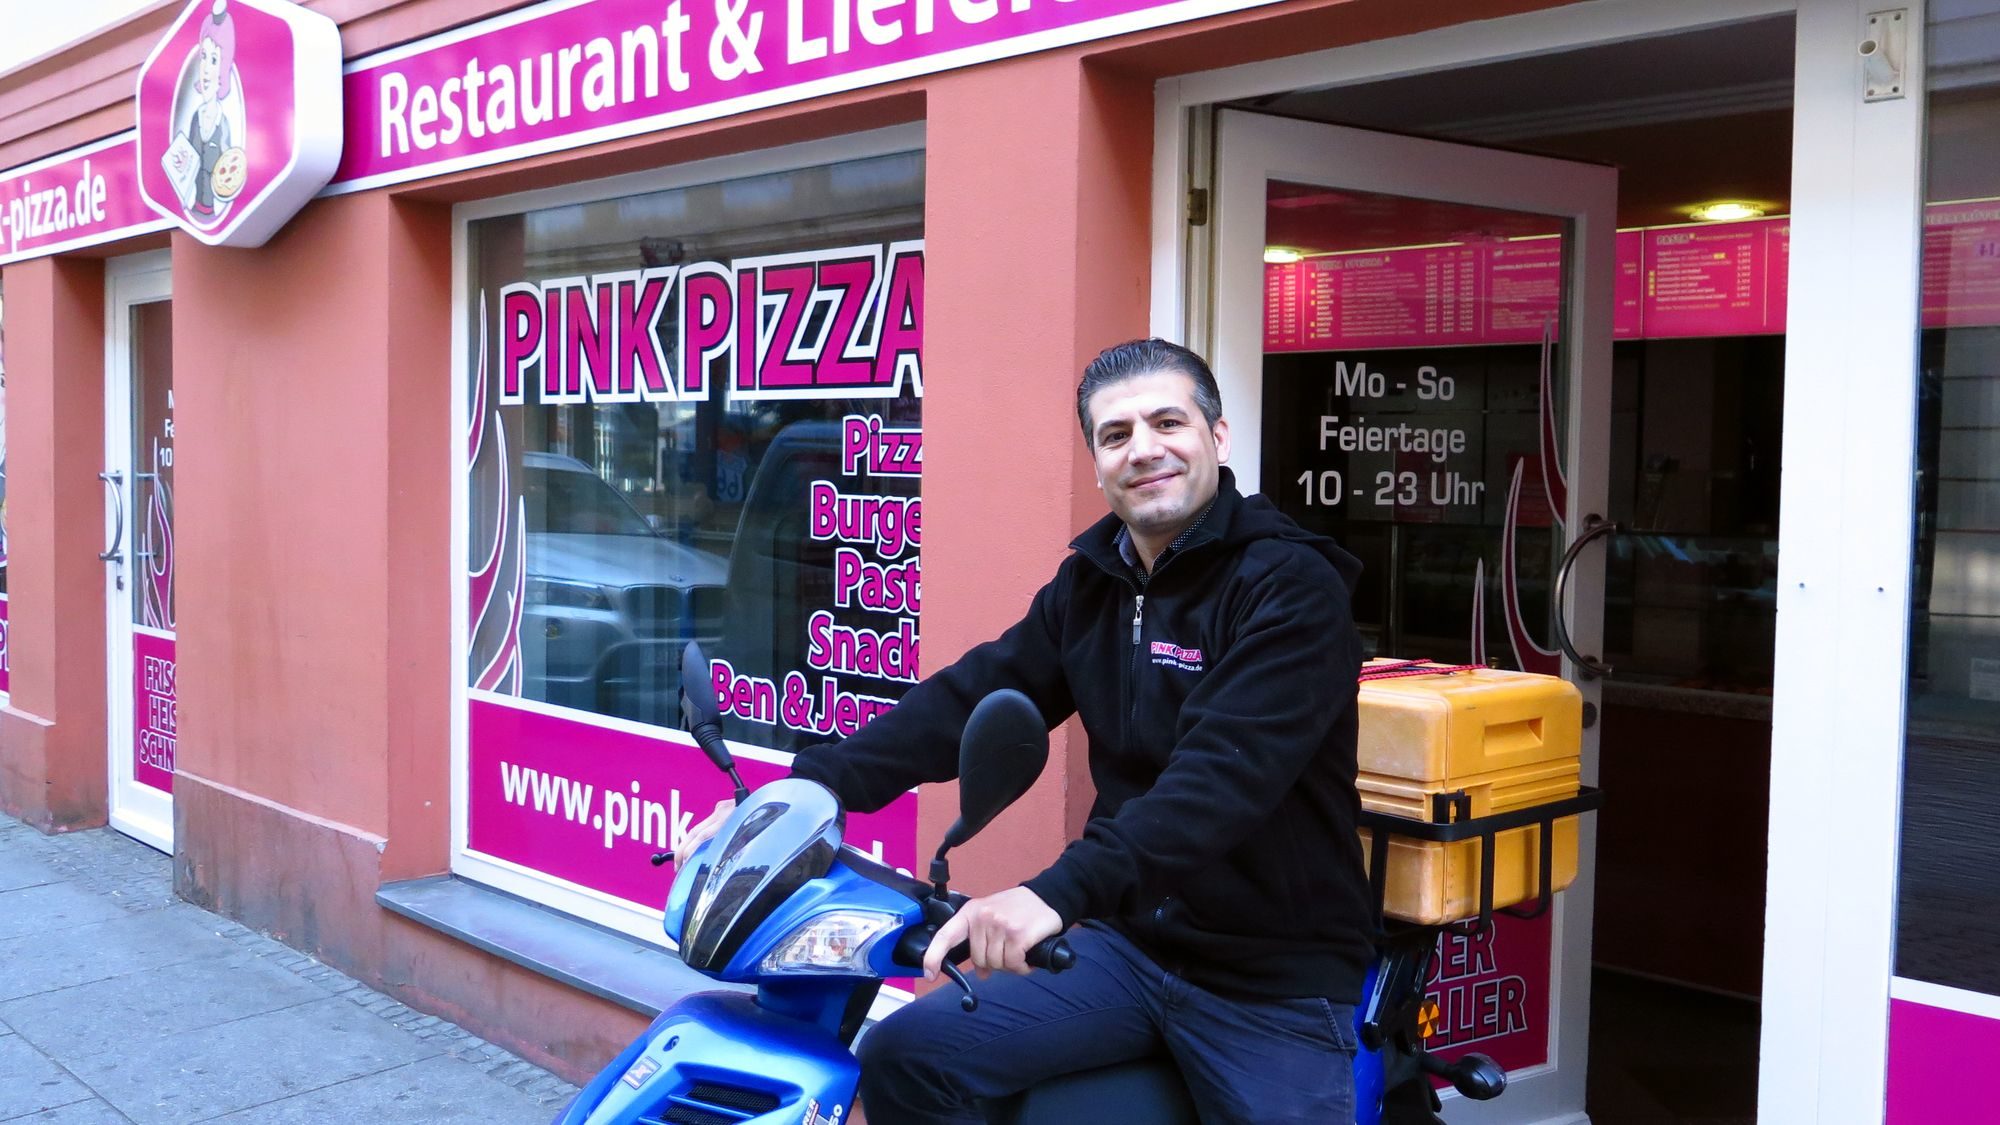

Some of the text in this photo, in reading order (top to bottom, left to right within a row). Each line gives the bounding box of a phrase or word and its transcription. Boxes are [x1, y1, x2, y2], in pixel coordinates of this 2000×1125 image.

[380, 3, 690, 157] Restaurant
[708, 0, 763, 76] &
[0, 158, 107, 254] -pizza.de
[501, 239, 924, 405] PINK PIZZA
[1335, 361, 1386, 398] Mo
[1416, 365, 1455, 400] So
[160, 447, 173, 467] 10
[842, 414, 923, 477] Pizz
[1319, 415, 1466, 462] Feiertage
[810, 480, 922, 559] Burge
[1297, 470, 1342, 505] 10
[1375, 471, 1418, 505] 23
[1430, 472, 1485, 505] Uhr
[835, 547, 921, 616] Past
[807, 609, 921, 684] Snack
[1151, 641, 1203, 662] PINK PIZZA
[710, 658, 777, 725] Ben
[780, 670, 815, 733] &
